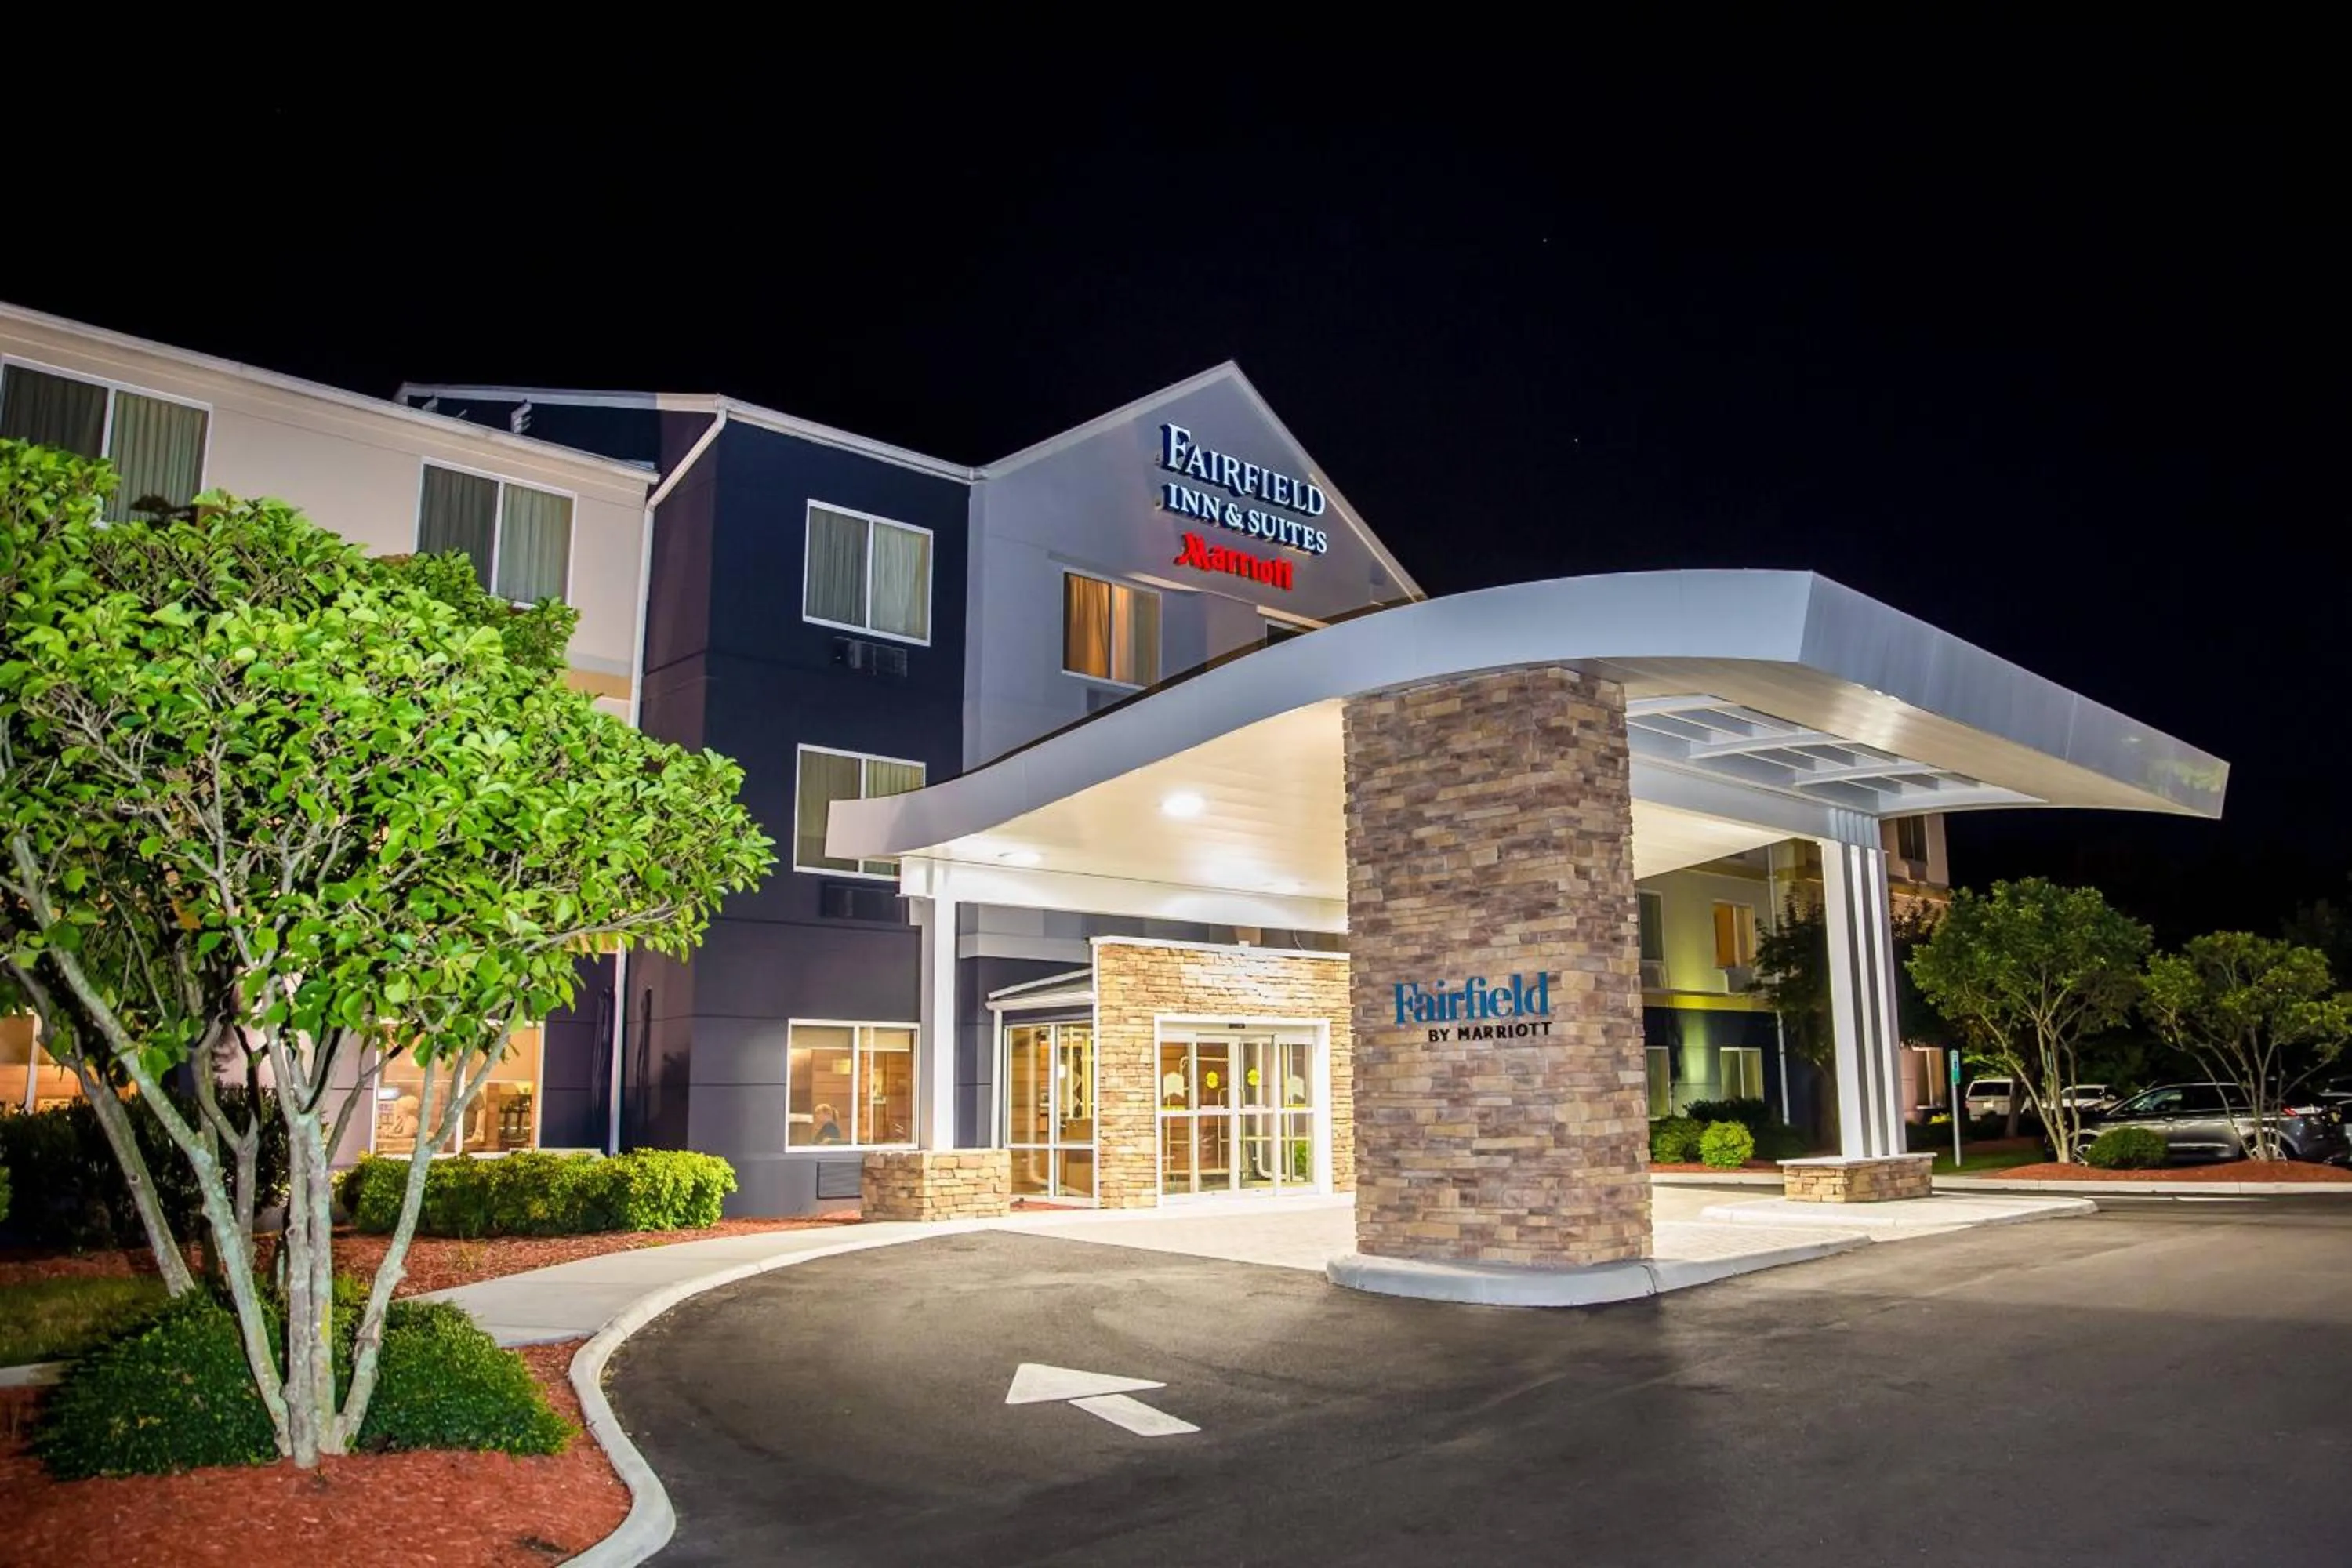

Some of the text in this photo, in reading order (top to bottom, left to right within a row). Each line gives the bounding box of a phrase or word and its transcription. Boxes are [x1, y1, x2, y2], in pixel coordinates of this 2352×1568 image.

[1162, 423, 1327, 517] FAIRFIELD
[1165, 482, 1328, 554] INN & SUITES
[1175, 531, 1293, 590] Marriott
[1394, 971, 1549, 1025] Fairfield
[1428, 1022, 1552, 1042] BY MARRIOTT
